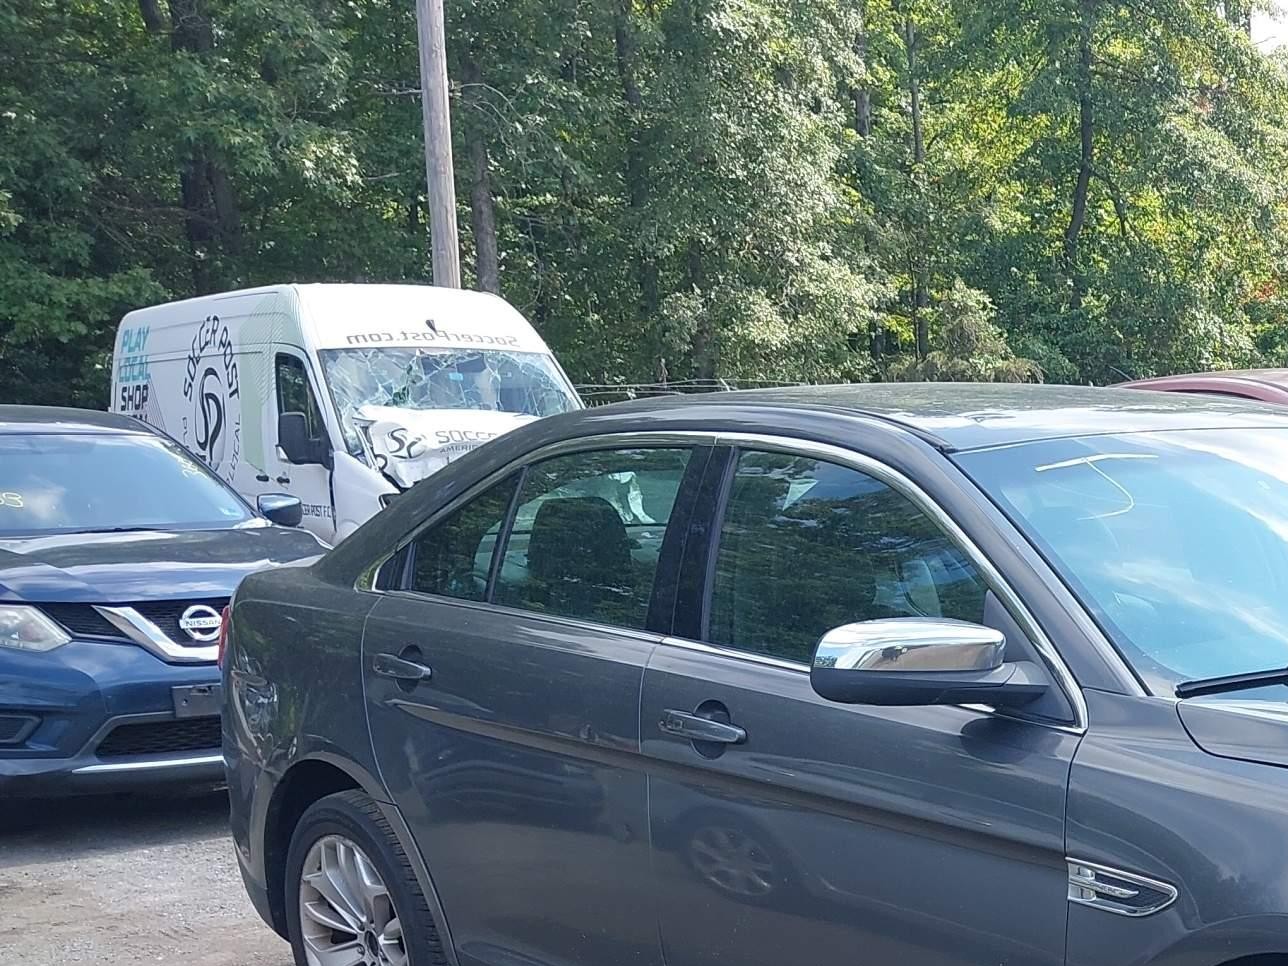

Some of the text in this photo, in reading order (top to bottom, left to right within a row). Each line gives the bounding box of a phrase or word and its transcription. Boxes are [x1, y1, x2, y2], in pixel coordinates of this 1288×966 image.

[122, 325, 150, 354] PLAY
[118, 355, 151, 384] LOCAL
[184, 315, 240, 402] SOCCER POST
[120, 384, 149, 411] SHOP
